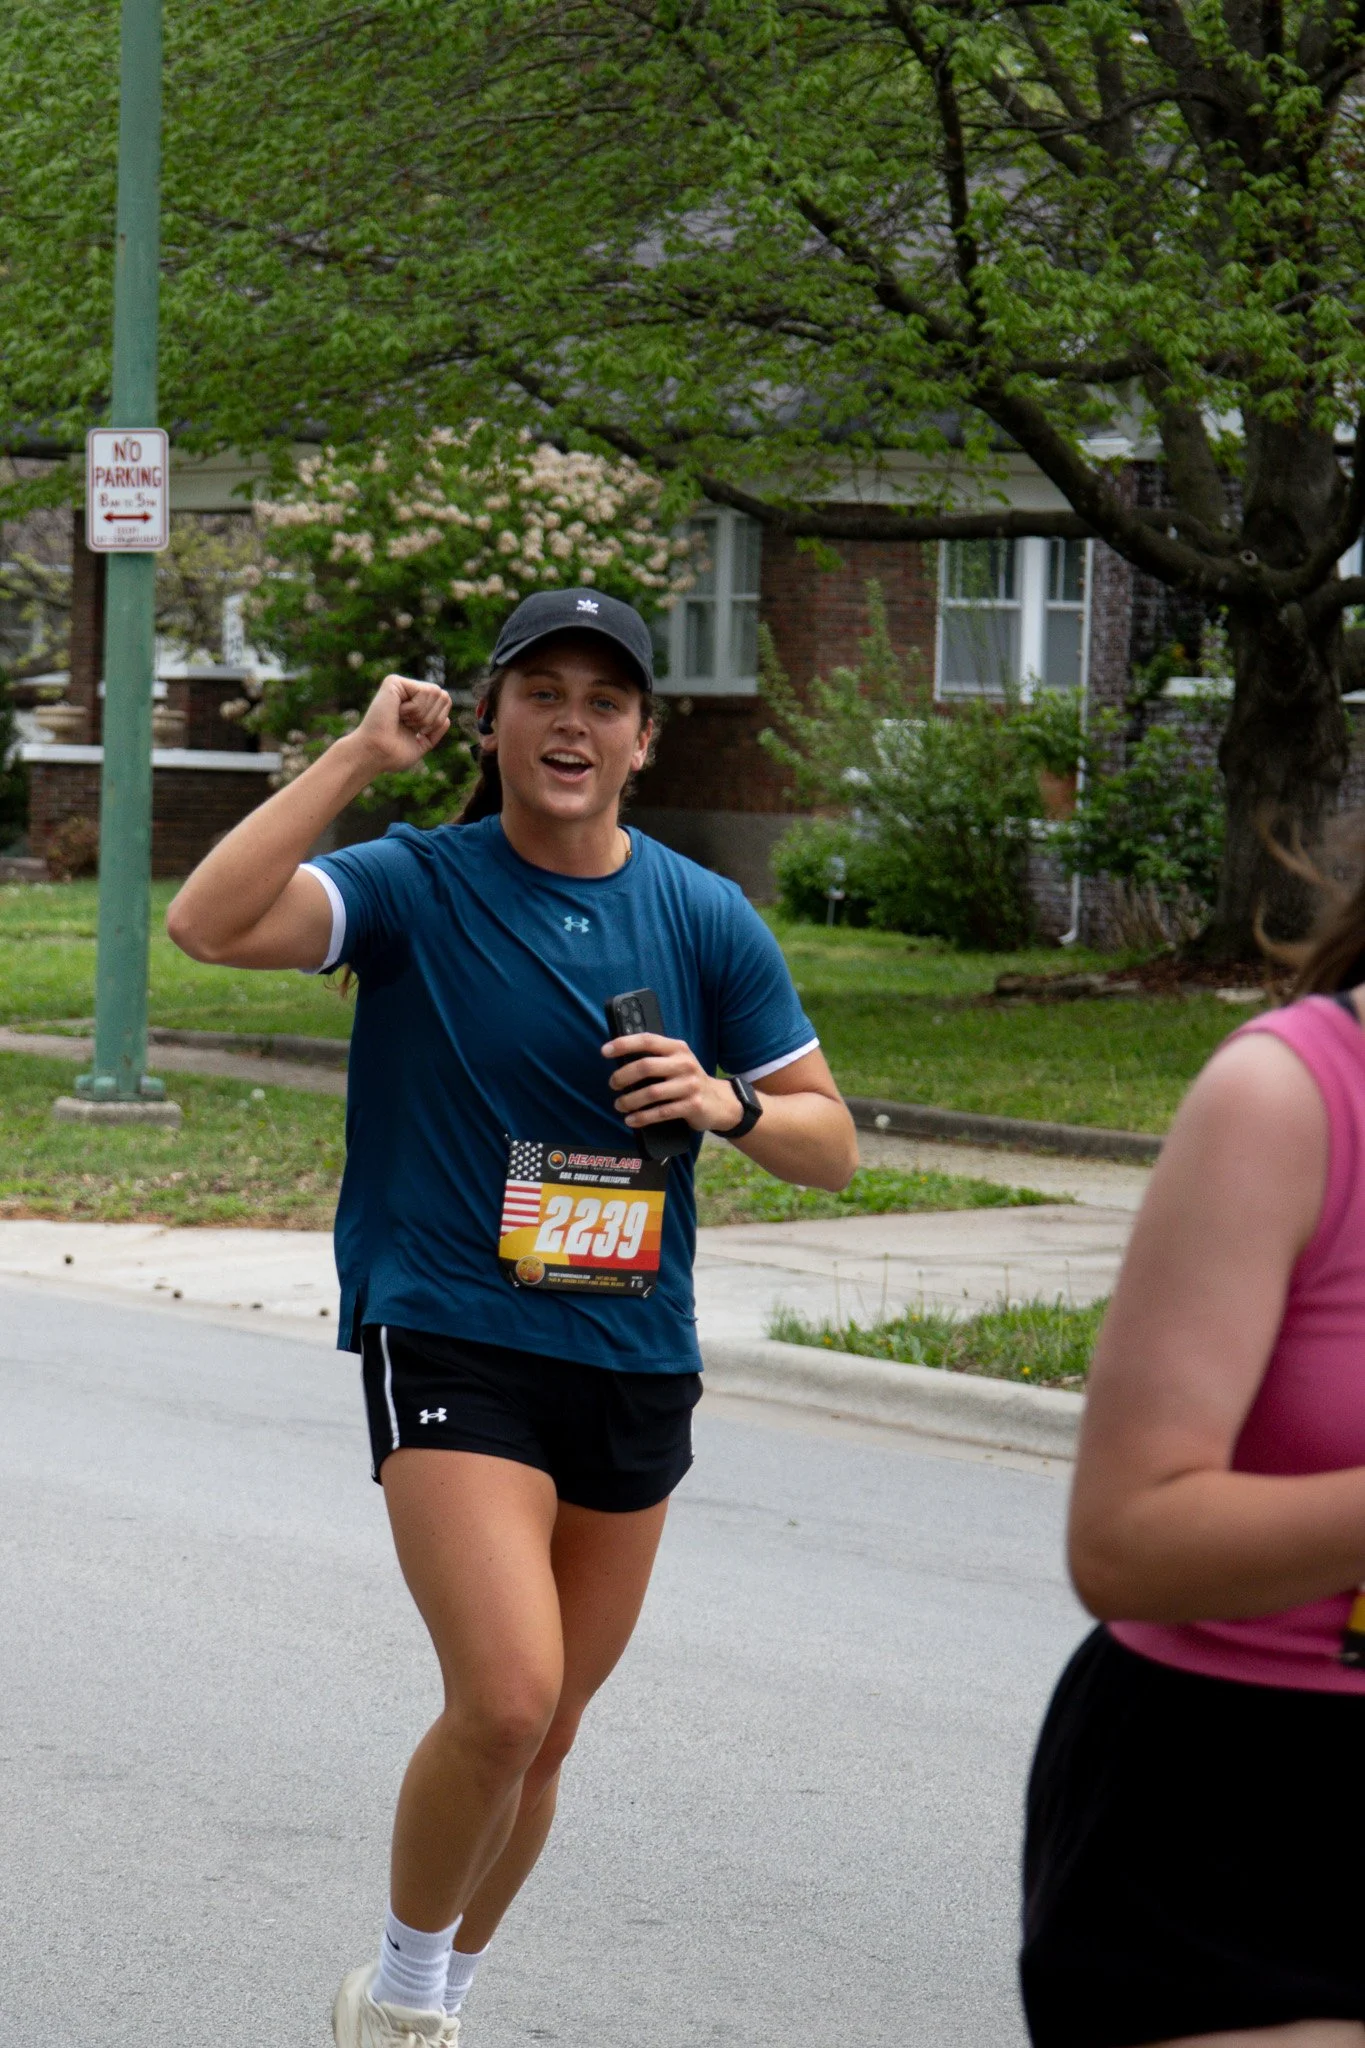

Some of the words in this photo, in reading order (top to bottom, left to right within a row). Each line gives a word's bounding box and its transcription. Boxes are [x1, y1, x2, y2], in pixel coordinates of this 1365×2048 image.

[112, 440, 142, 462] NO
[95, 466, 162, 488] PARKING
[568, 1153, 642, 1169] HEARTLAND
[534, 1195, 649, 1259] 2239
